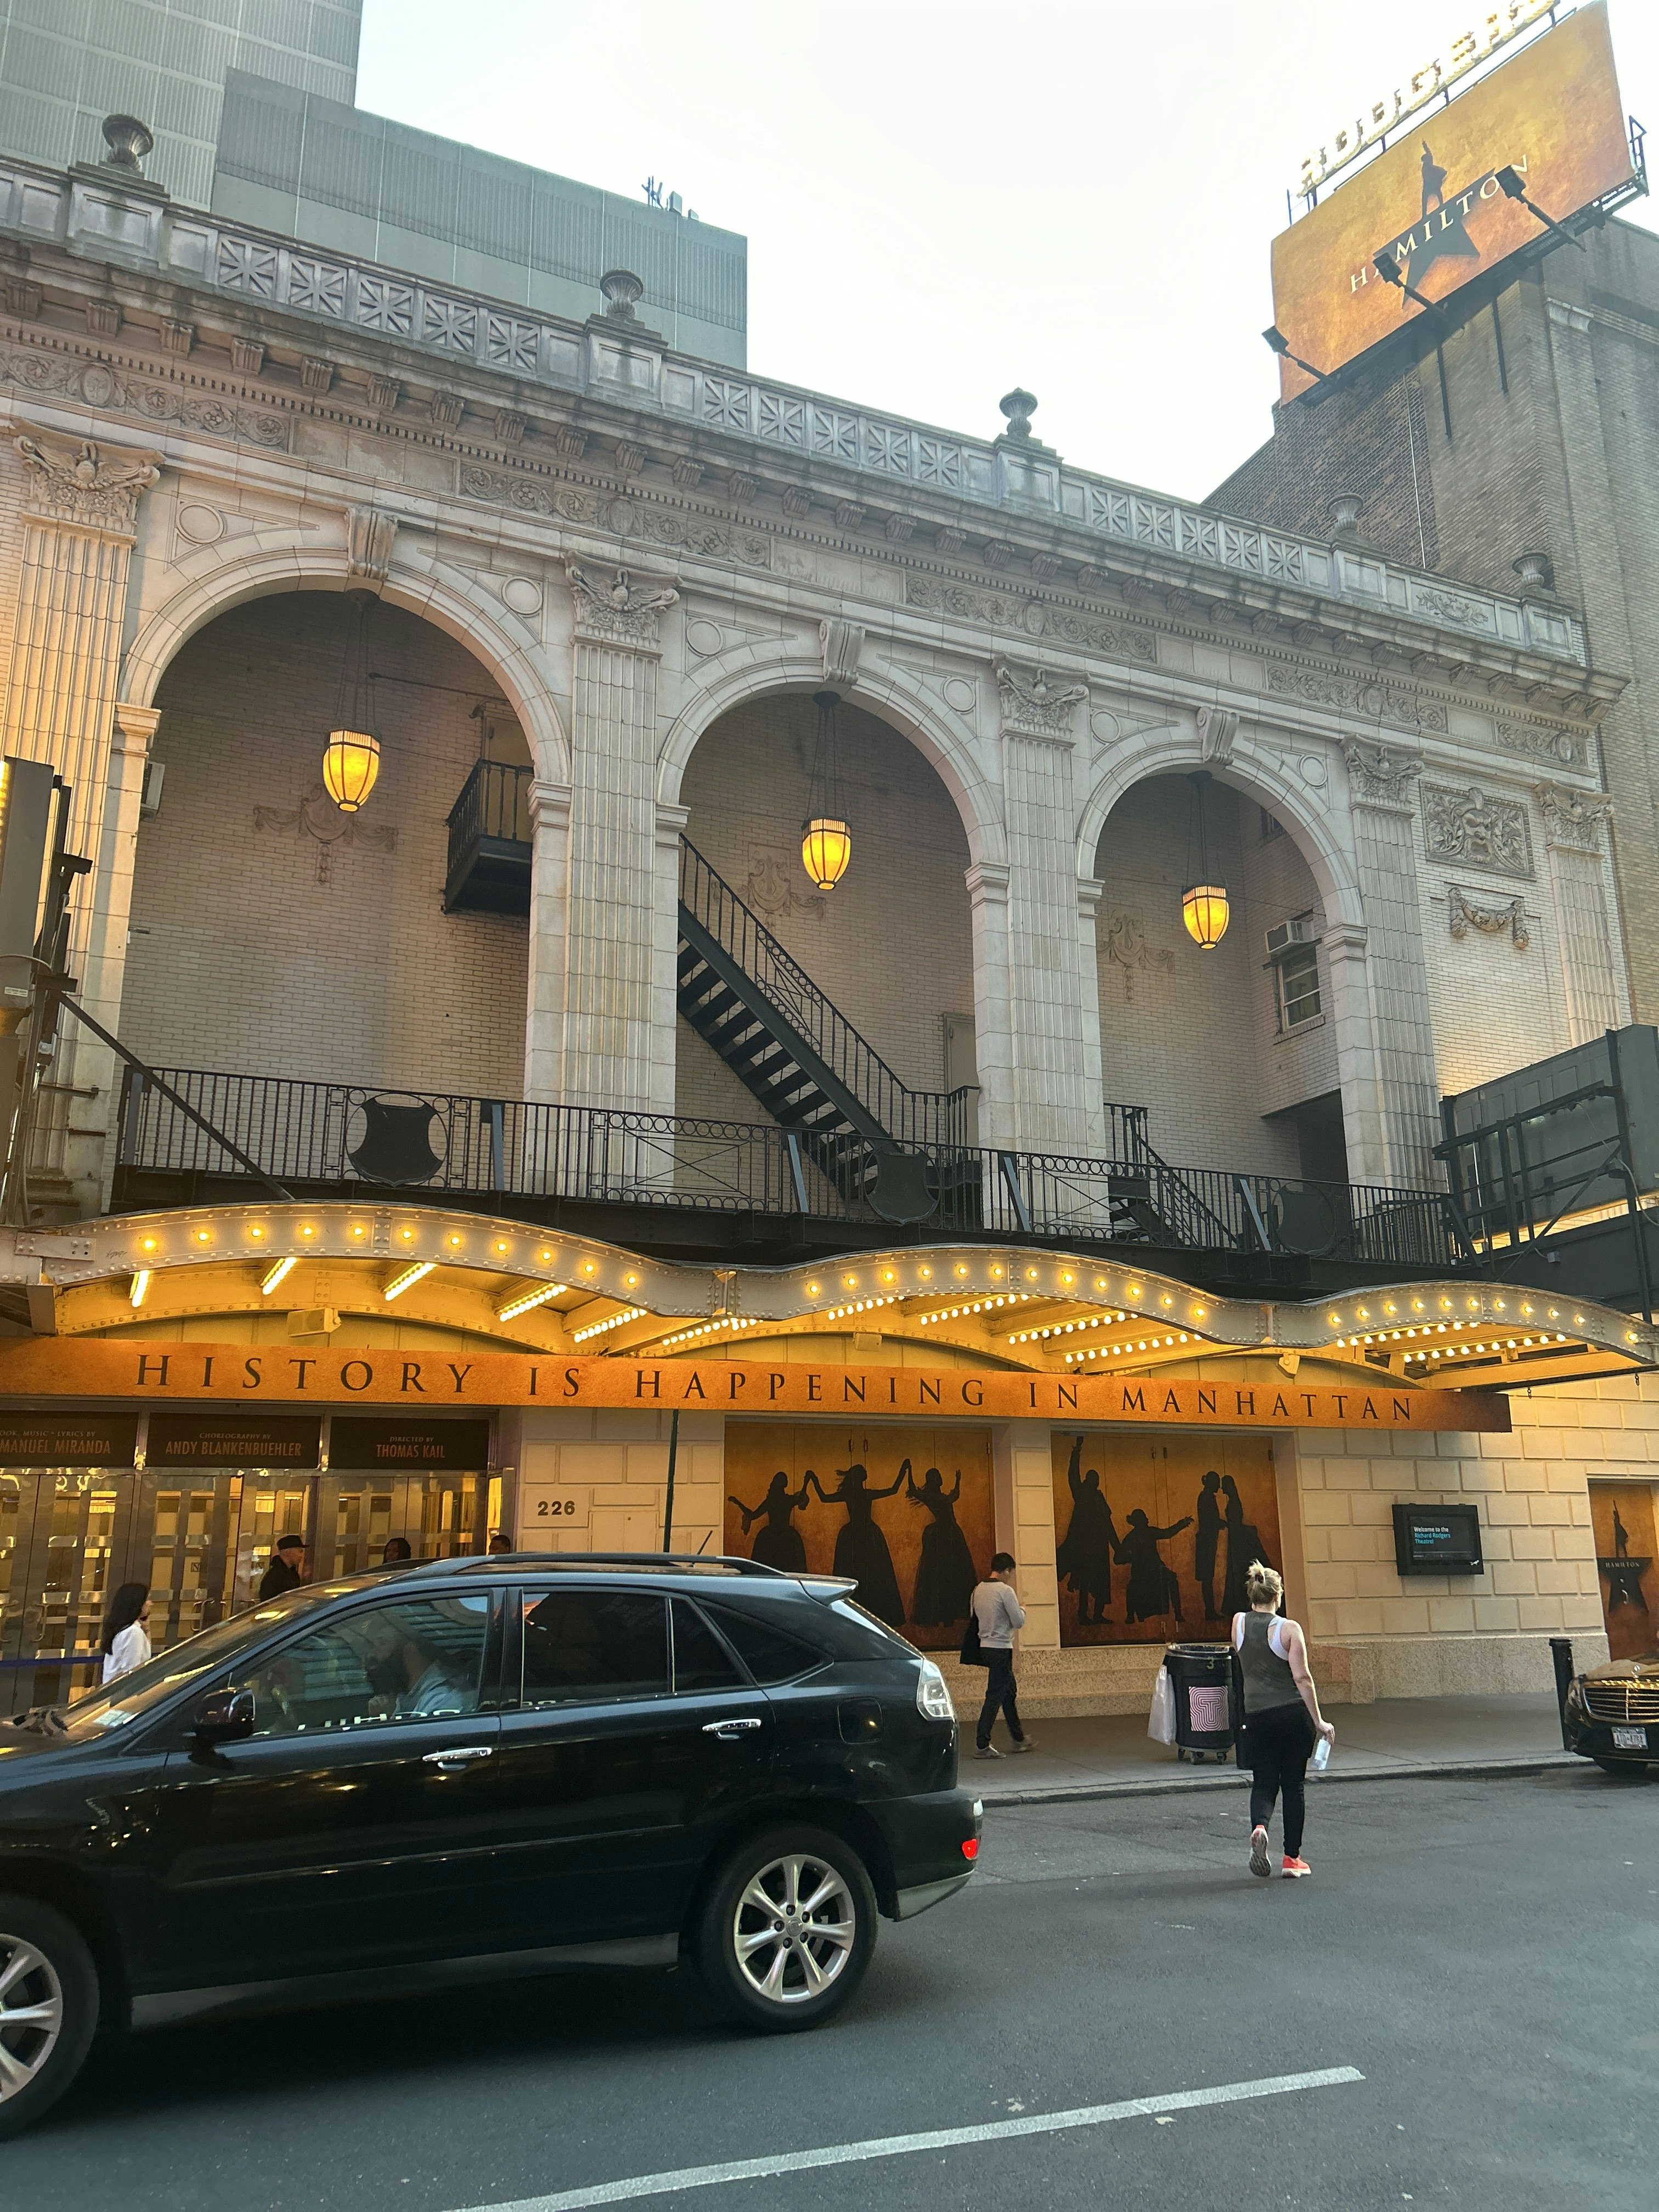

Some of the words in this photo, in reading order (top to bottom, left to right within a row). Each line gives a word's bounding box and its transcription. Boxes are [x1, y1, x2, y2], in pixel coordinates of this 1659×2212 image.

[1350, 154, 1527, 294] HMILTON
[136, 1354, 475, 1393] HISTORY
[528, 1367, 580, 1397] IS
[636, 1370, 985, 1406] HAPPENING
[1029, 1382, 1079, 1409] IN
[1121, 1386, 1410, 1421] MANHATTAN
[54, 1439, 110, 1454] MIRANDA
[165, 1441, 198, 1454] ANDY
[201, 1441, 302, 1457] BLANKENBUEHLER
[376, 1444, 419, 1458] THOMAS
[422, 1444, 446, 1458] KAIL
[538, 1500, 575, 1516] 226
[1206, 1656, 1214, 1669] 3
